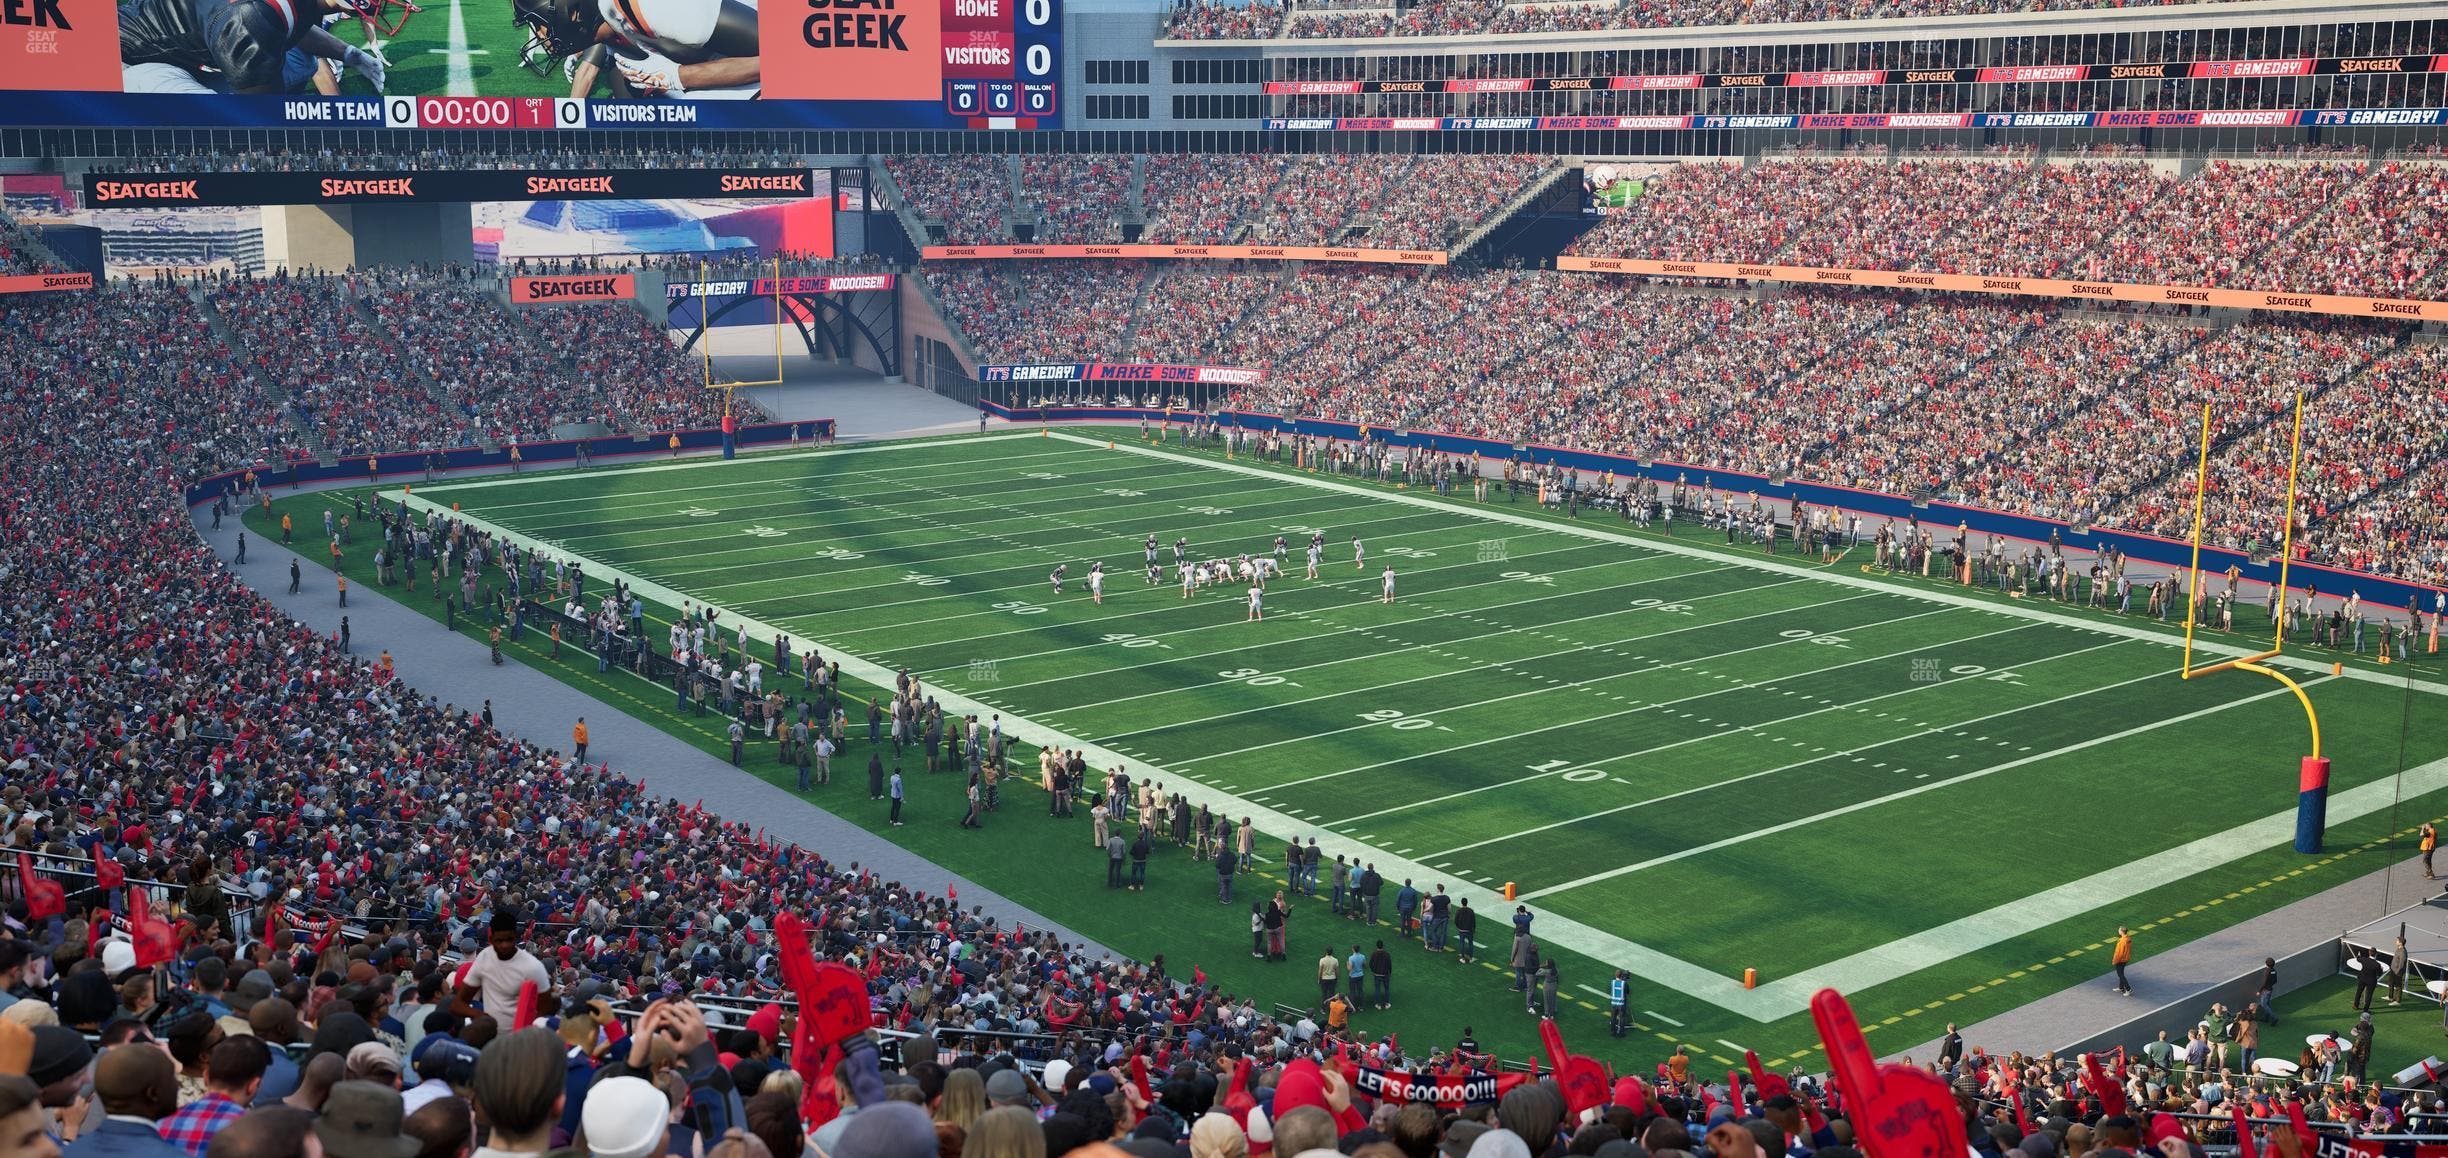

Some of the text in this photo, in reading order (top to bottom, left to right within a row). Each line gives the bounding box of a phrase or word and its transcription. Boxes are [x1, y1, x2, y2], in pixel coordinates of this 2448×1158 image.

[955, 0, 998, 17] HOME
[1025, 0, 1050, 25] 0
[803, 13, 909, 51] GEEK
[945, 47, 1010, 65] VISITORS
[1026, 44, 1050, 75] 0
[2111, 65, 2165, 78] SEATGEEK
[2208, 61, 2302, 76] IT'S GAMEDAY!
[2340, 58, 2402, 73] SEATGEEK
[1822, 73, 1875, 84] GAMEDAY!
[1906, 71, 1956, 82] SEATGEEK
[1992, 68, 2076, 80] IT'S GAMEDAY!
[1300, 83, 1352, 92] GAMEDAY!
[1380, 82, 1424, 92] SEATGEEK
[1476, 80, 1524, 90] GAMEDAY!
[1550, 79, 1591, 90] SEATGEEK
[1643, 77, 1692, 87] GAMEDAY!
[1720, 75, 1765, 87] SEATGEEK
[526, 98, 543, 108] QRT
[958, 93, 971, 108] 0
[995, 93, 1008, 108] 0
[1032, 93, 1044, 108] 0
[284, 102, 380, 120] HOME TEAM
[392, 100, 411, 124] 0
[424, 100, 510, 124] 00:00
[531, 109, 538, 124] 1
[562, 101, 580, 124] 0
[592, 104, 696, 122] VISITORS TEAM
[2315, 111, 2440, 124] IT'S GAMEDAY!
[1269, 119, 1332, 129] IT'S GAMEDAY!
[1345, 120, 1368, 129] MAKE
[1372, 120, 1392, 129] SOME
[1452, 118, 1532, 128] IT'S GAMEDAY!
[1549, 118, 1580, 128] MAKE
[1586, 118, 1616, 127] SOME
[1704, 116, 1792, 127] IT'S GAMEDAY!
[1810, 115, 1962, 126] MAKE SOME NOOOOISE!!!
[1985, 114, 2087, 126] IT'S GAMEDAY!
[2108, 112, 2287, 125] MAKE SOME NOOOOISE!!!
[321, 177, 414, 197] SEATGEEK
[526, 176, 614, 194] SEATGEEK
[721, 174, 804, 192] SEATGEEK
[95, 180, 199, 201] SEATGEEK
[946, 248, 976, 256] SEATGEEK
[1085, 247, 1120, 255] SEATGEEK
[1325, 250, 1358, 258] SEATGEEK
[1400, 253, 1434, 261] SEATGEEK
[1590, 260, 1622, 270] SEATGEEK
[1662, 264, 1696, 273] SEATGEEK
[1738, 267, 1772, 277] SEATGEEK
[1816, 271, 1851, 281] SEATGEEK
[43, 276, 91, 288] SEATGEEK
[762, 279, 794, 293] MAKE
[799, 278, 826, 291] SOME
[1897, 276, 1934, 286] SEATGEEK
[1982, 279, 2021, 290] SEATGEEK
[529, 278, 618, 298] SEATGEEK
[666, 284, 688, 297] IT'S
[2072, 284, 2113, 296] SEATGEEK
[2166, 290, 2209, 302] SEATGEEK
[2266, 296, 2312, 308] SEATGEEK
[2372, 302, 2422, 315] SEATGEEK
[986, 365, 1075, 381] IT'S GAMEDAY!
[1100, 367, 1155, 379] MAKE
[1161, 367, 1196, 380] SOME
[816, 549, 865, 560] 30
[901, 574, 951, 586] 40
[992, 600, 1048, 615] 50
[1100, 633, 1158, 648] 40
[1218, 668, 1286, 686] 30
[1356, 710, 1434, 730] 20
[1525, 760, 1607, 782] 10
[1357, 1068, 1496, 1102] LET'S GOOOOO!!!
